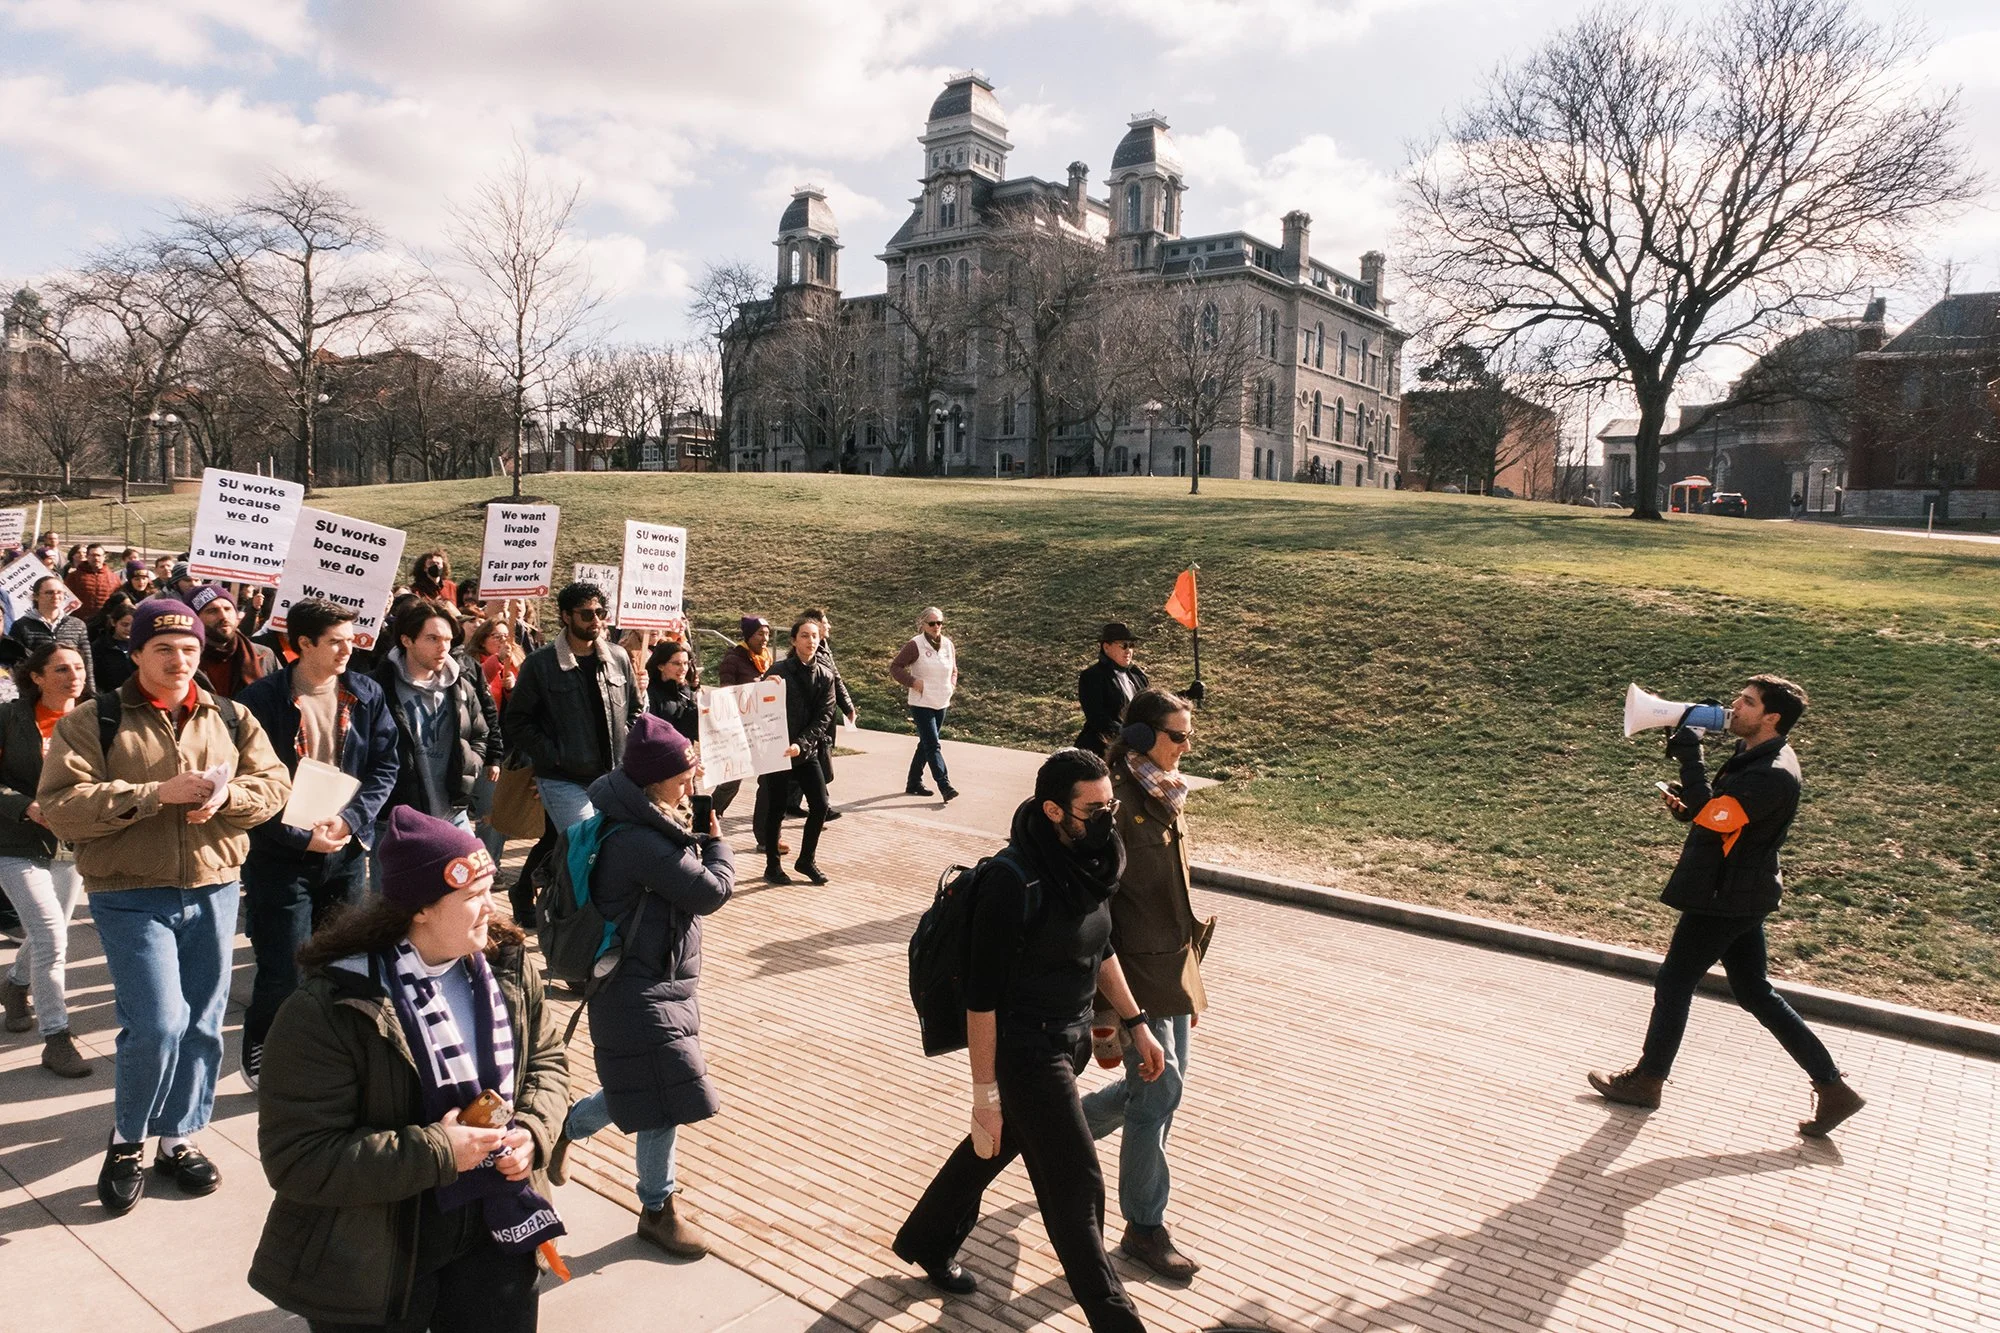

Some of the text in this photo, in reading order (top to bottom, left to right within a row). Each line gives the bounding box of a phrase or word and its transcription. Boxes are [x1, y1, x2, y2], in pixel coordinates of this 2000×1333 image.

[218, 478, 285, 497] SU works
[219, 493, 281, 511] because
[227, 511, 269, 524] we do
[501, 511, 546, 520] We want
[315, 519, 387, 547] SU works
[504, 524, 540, 533] livable
[215, 534, 274, 551] We want
[504, 539, 537, 548] wages
[636, 530, 679, 544] SU works
[313, 538, 380, 562] because
[637, 545, 676, 558] because
[197, 548, 286, 567] a union now!
[320, 559, 365, 576] we do
[488, 560, 547, 570] Fair pay for
[642, 562, 669, 572] we do
[7, 563, 31, 581] works
[493, 573, 540, 582] fair work
[16, 590, 29, 600] we
[303, 584, 365, 608] We want
[634, 586, 672, 598] We want
[281, 599, 376, 627] a w!
[631, 601, 657, 610] union
[659, 603, 680, 612] now!
[153, 614, 194, 627] SEIU
